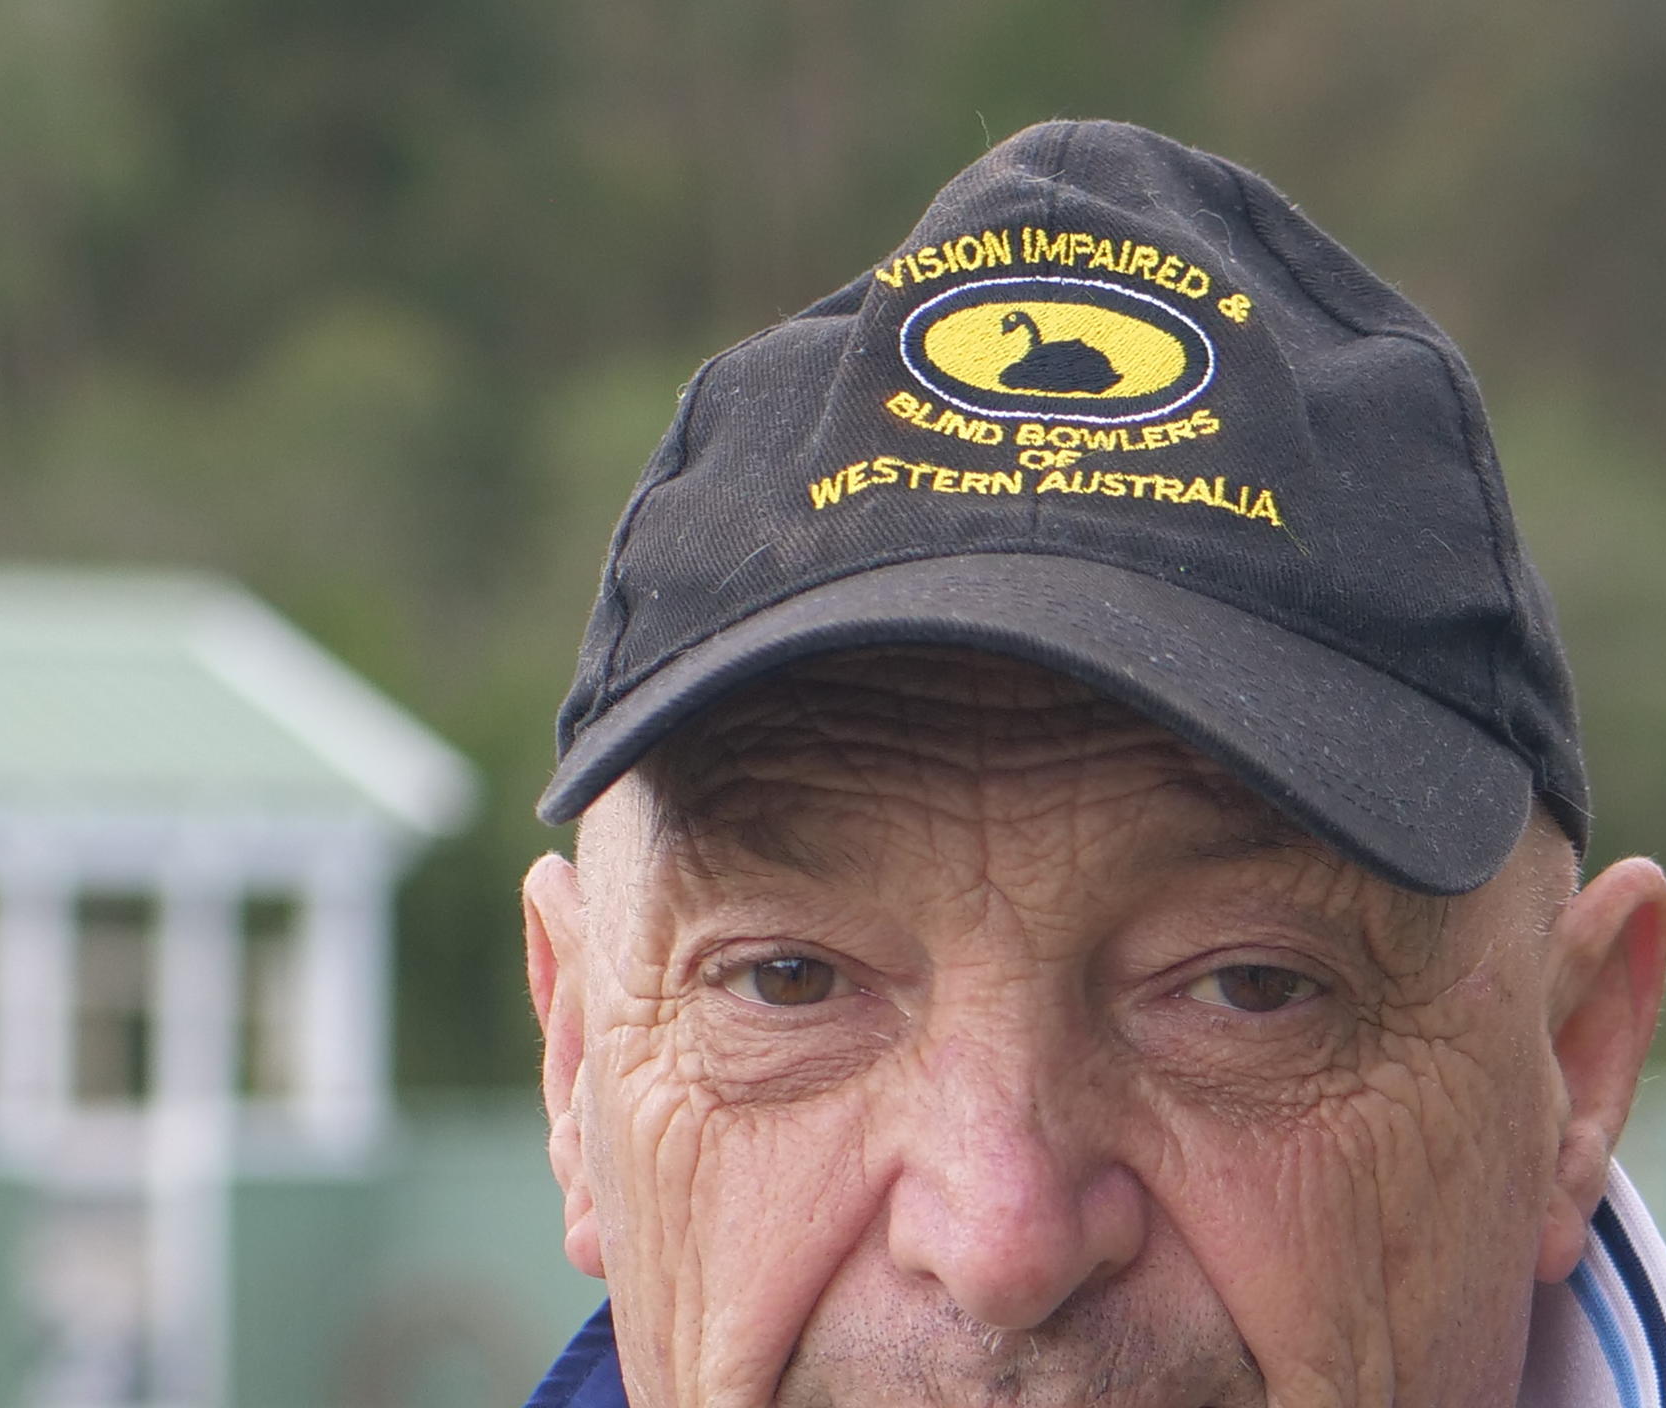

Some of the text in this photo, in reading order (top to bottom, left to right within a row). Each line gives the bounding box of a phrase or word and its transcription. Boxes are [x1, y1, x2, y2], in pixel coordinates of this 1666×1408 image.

[876, 227, 1255, 324] VISION IMPAIRED &
[885, 391, 1220, 450] BLIND BOWLERS
[809, 456, 1281, 527] WESTERN AUSTRALIA
[1019, 449, 1083, 470] OF
